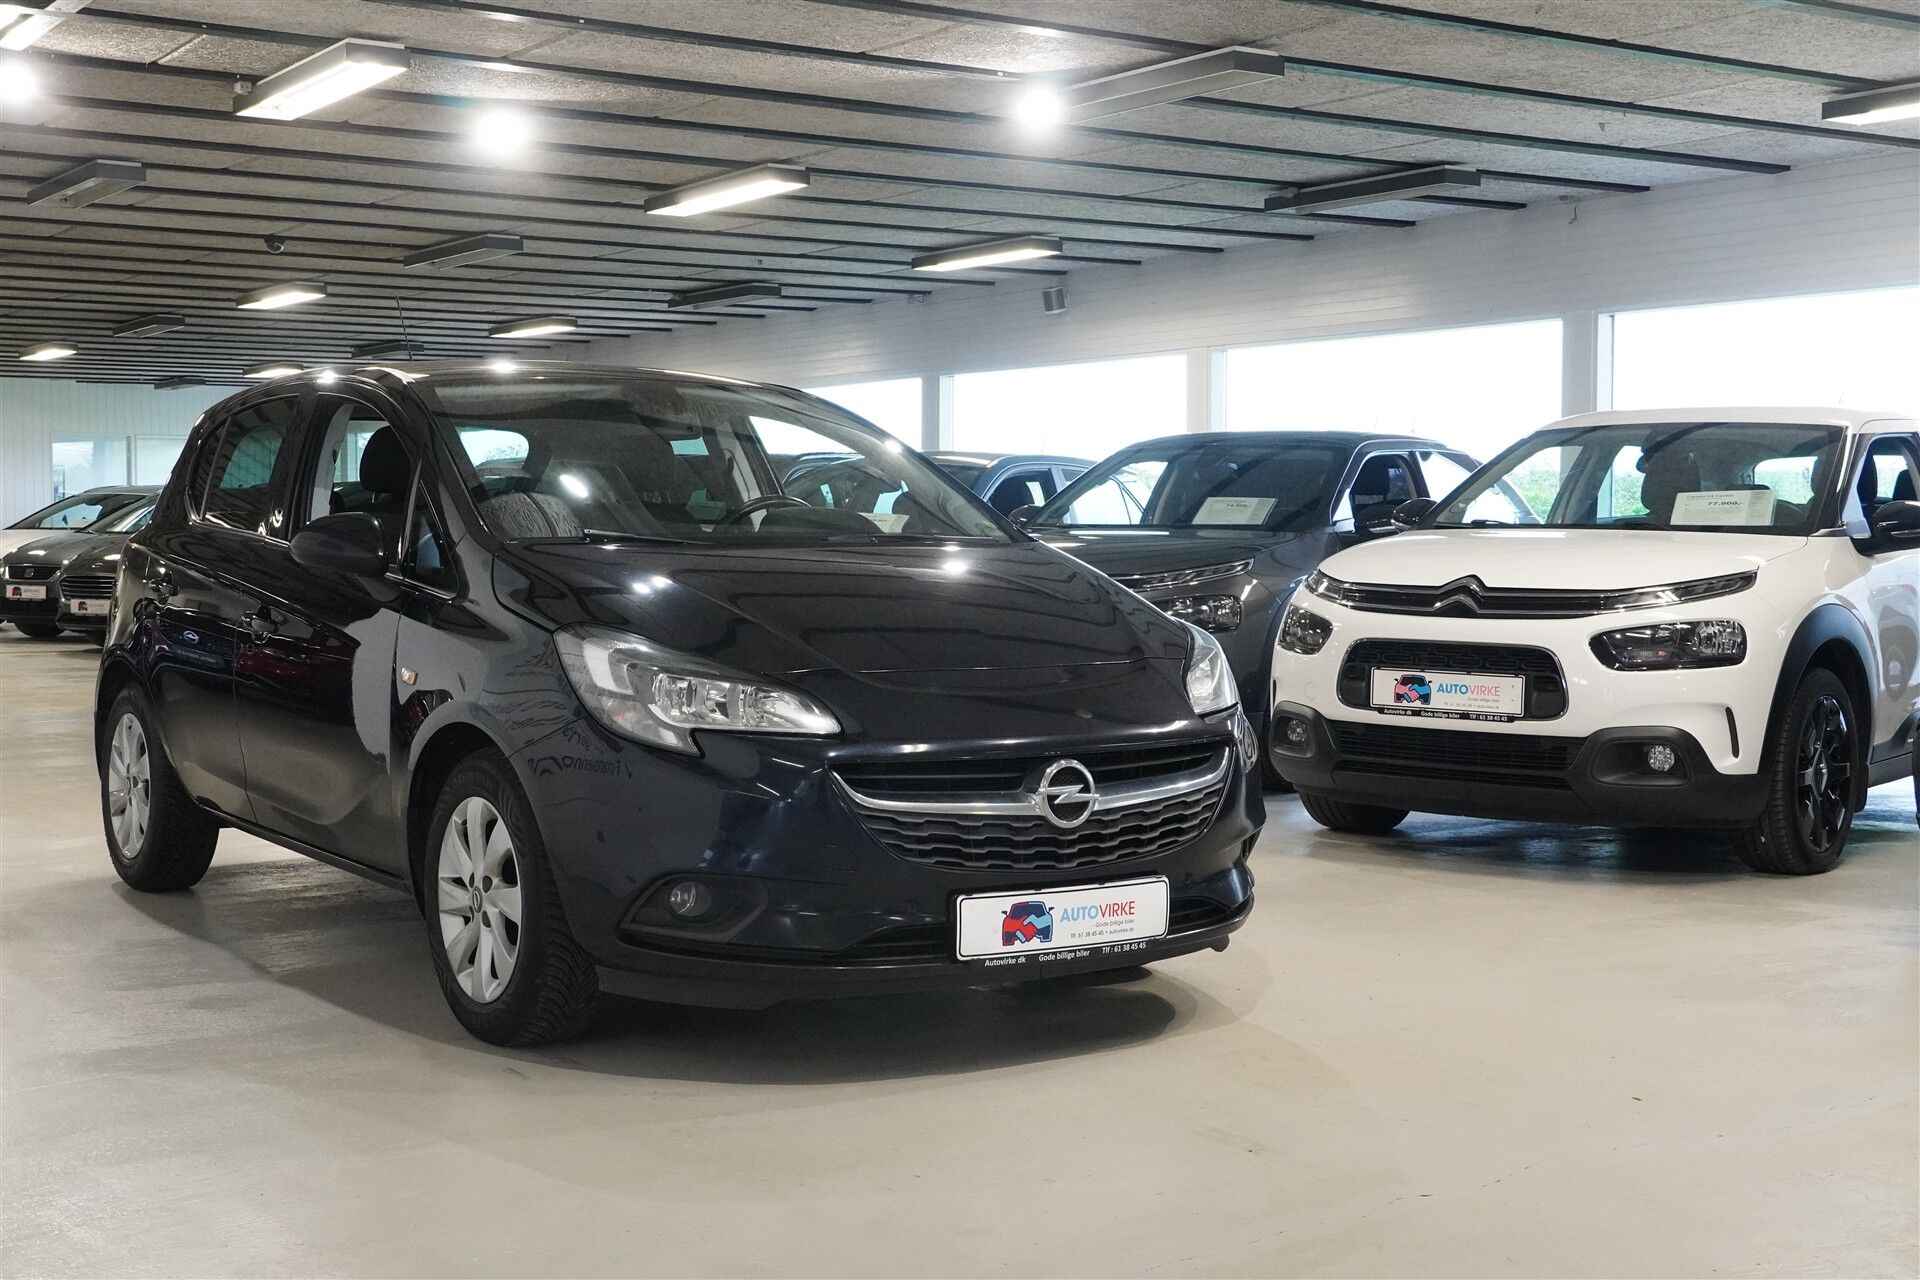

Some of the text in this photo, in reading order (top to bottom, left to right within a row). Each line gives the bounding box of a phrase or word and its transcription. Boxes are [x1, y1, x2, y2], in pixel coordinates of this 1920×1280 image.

[1436, 683, 1500, 697] AUTOVIRKE
[1059, 900, 1136, 923] AUTOVIRKE
[984, 957, 1016, 967] Autovirke
[1039, 953, 1056, 961] Gode
[1056, 951, 1075, 960] billige
[1076, 949, 1090, 958] biler
[1114, 945, 1121, 953] 61
[1122, 943, 1130, 951] 38
[1130, 942, 1138, 950] 45
[1139, 941, 1147, 949] 45
